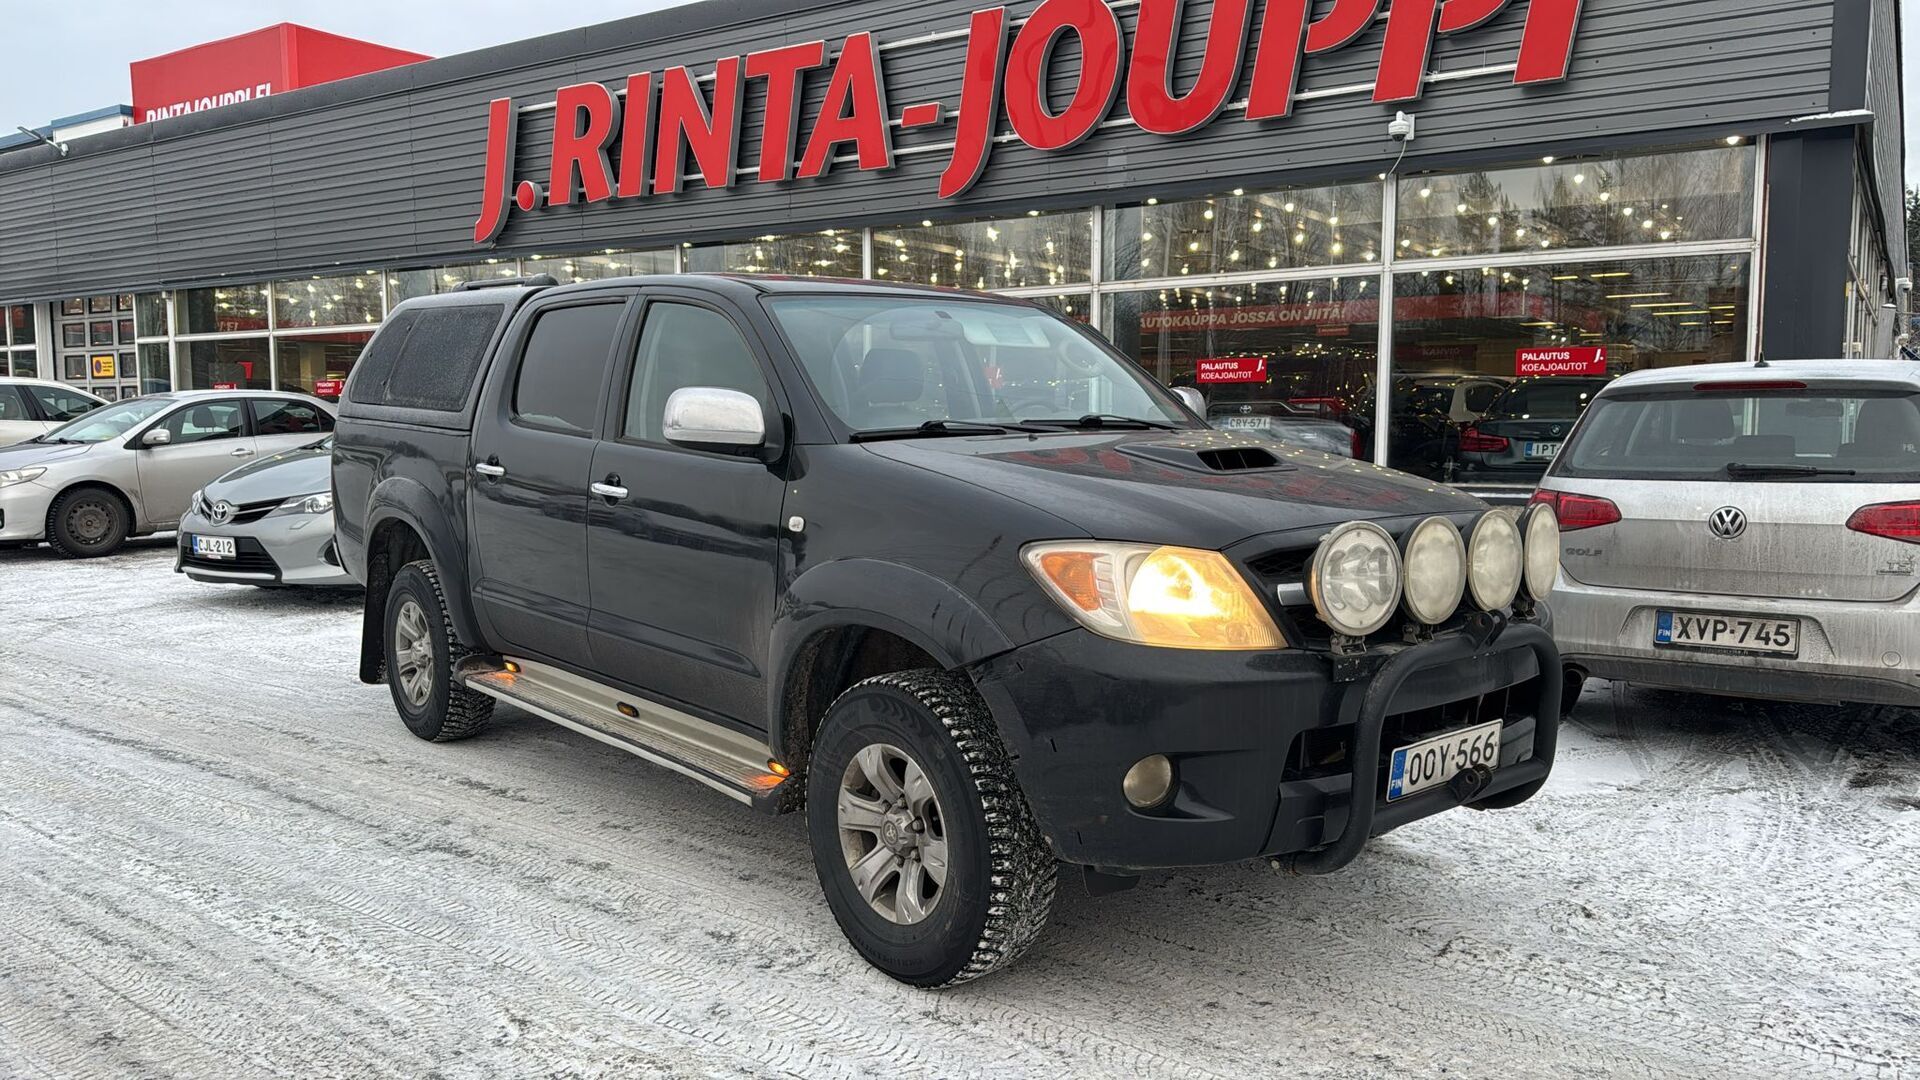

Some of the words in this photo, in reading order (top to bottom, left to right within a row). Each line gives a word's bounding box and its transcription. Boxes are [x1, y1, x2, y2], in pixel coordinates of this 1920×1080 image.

[1230, 311, 1276, 324] JOSSA
[1279, 309, 1302, 321] ON
[1522, 351, 1570, 361] PALAUTUS
[1200, 362, 1239, 371] PALAUTUS
[1522, 362, 1588, 372] KOEAJOAUTOT
[1200, 371, 1253, 380] KOEAJOAUTOT
[198, 538, 233, 554] CJL-212
[1566, 547, 1603, 557] GOLF
[1657, 628, 1671, 638] FIN
[1677, 616, 1792, 647] XVP-745
[1408, 730, 1496, 786] OOY-566
[1390, 778, 1403, 789] FIN
